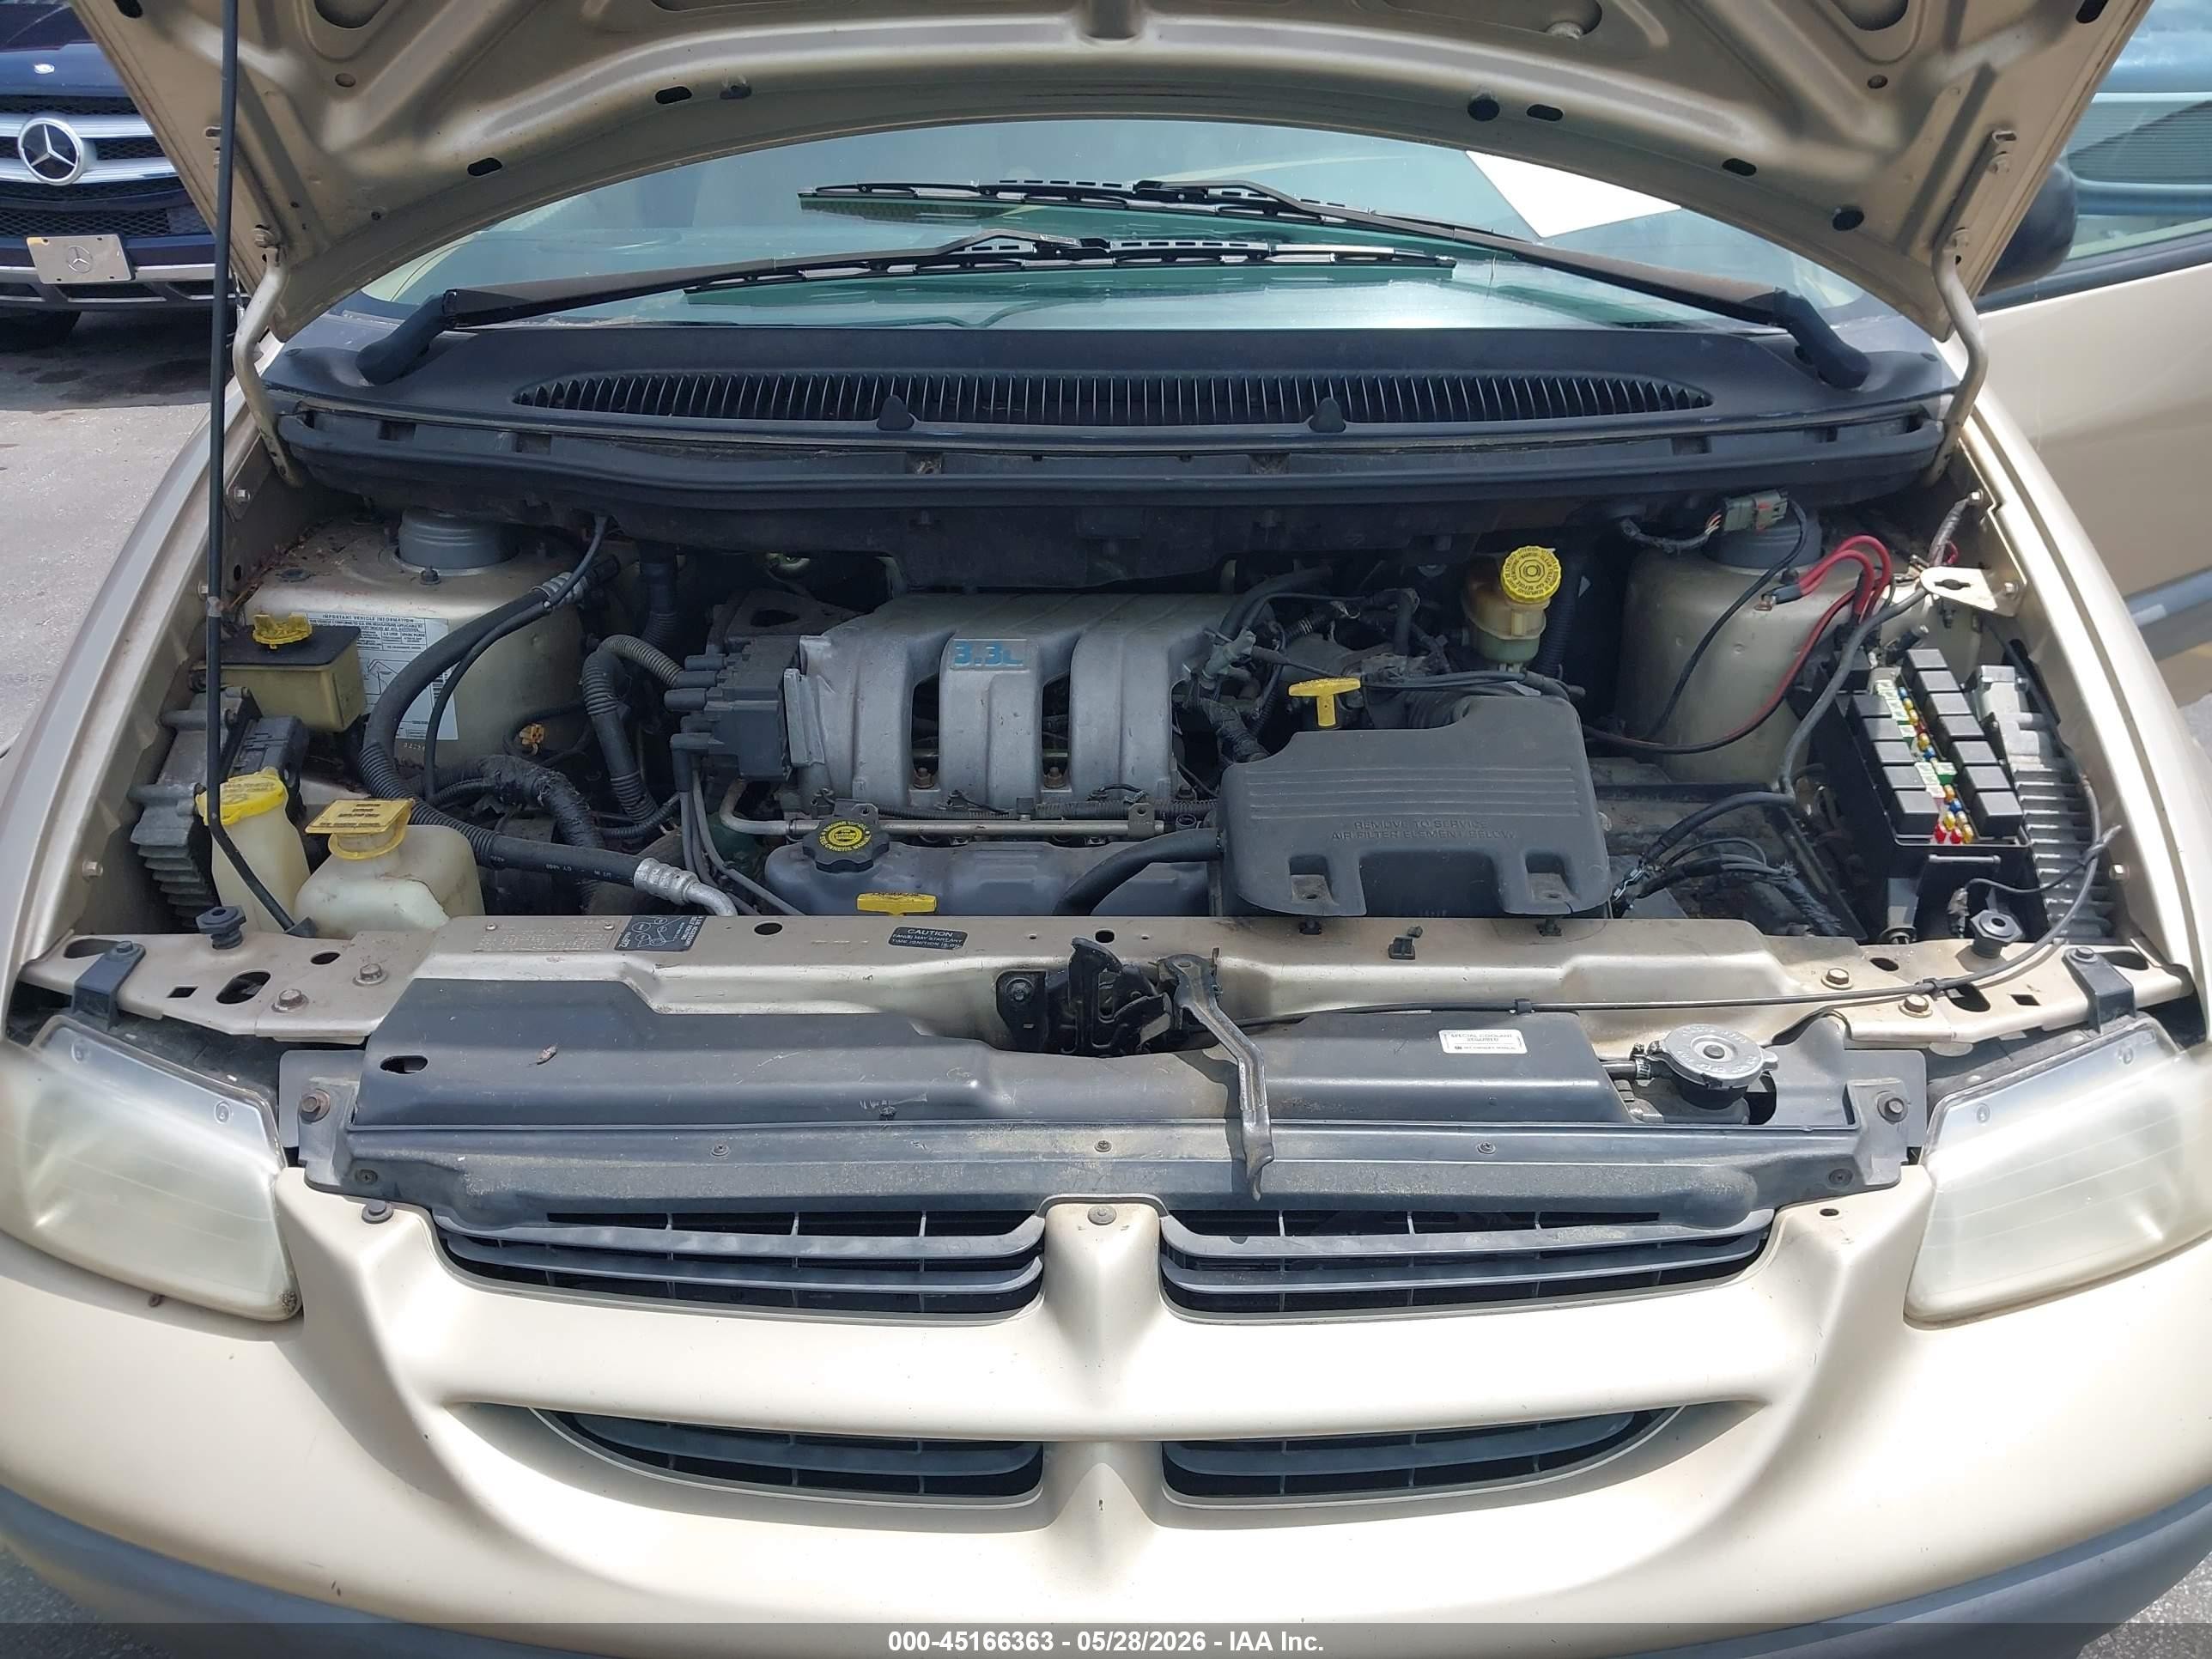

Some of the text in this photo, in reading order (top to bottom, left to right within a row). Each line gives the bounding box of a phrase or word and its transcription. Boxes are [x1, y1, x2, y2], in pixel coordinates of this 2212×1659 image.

[953, 641, 1024, 666] 3.3L
[1353, 819, 1488, 830] REMOVE TO SERVICE
[1332, 830, 1352, 841] AIR
[1357, 830, 1399, 839] FILTER
[1403, 830, 1463, 839] ELEMENT
